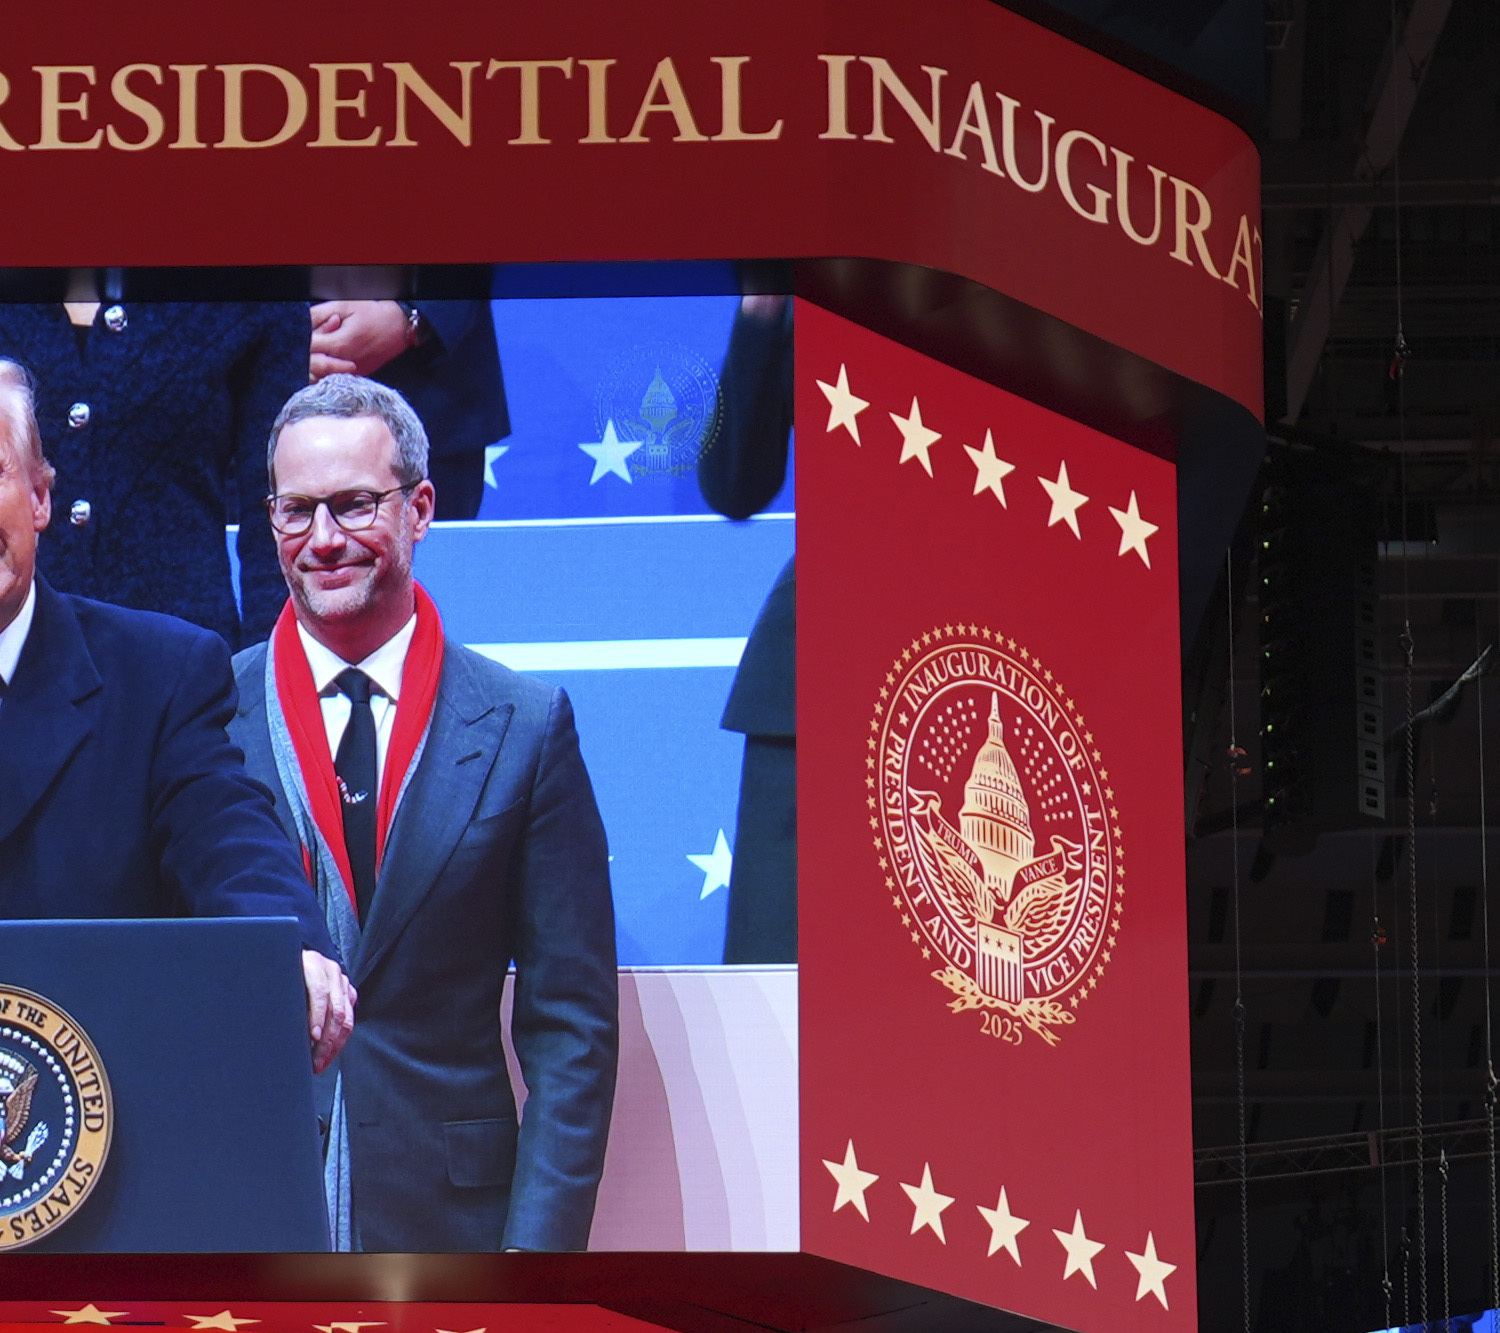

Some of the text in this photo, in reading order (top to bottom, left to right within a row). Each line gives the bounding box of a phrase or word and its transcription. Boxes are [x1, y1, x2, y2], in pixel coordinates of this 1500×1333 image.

[902, 651, 1086, 771] INAUGURATION OF
[884, 728, 1111, 997] PRESIDENT AND VICE PRESIDENT
[936, 819, 978, 866] TRUMP
[1019, 856, 1059, 884] VANCE
[16, 1002, 48, 1029] THE
[979, 1011, 1024, 1046] 2025
[51, 1023, 105, 1133] UNITED
[9, 1158, 94, 1241] STATES
